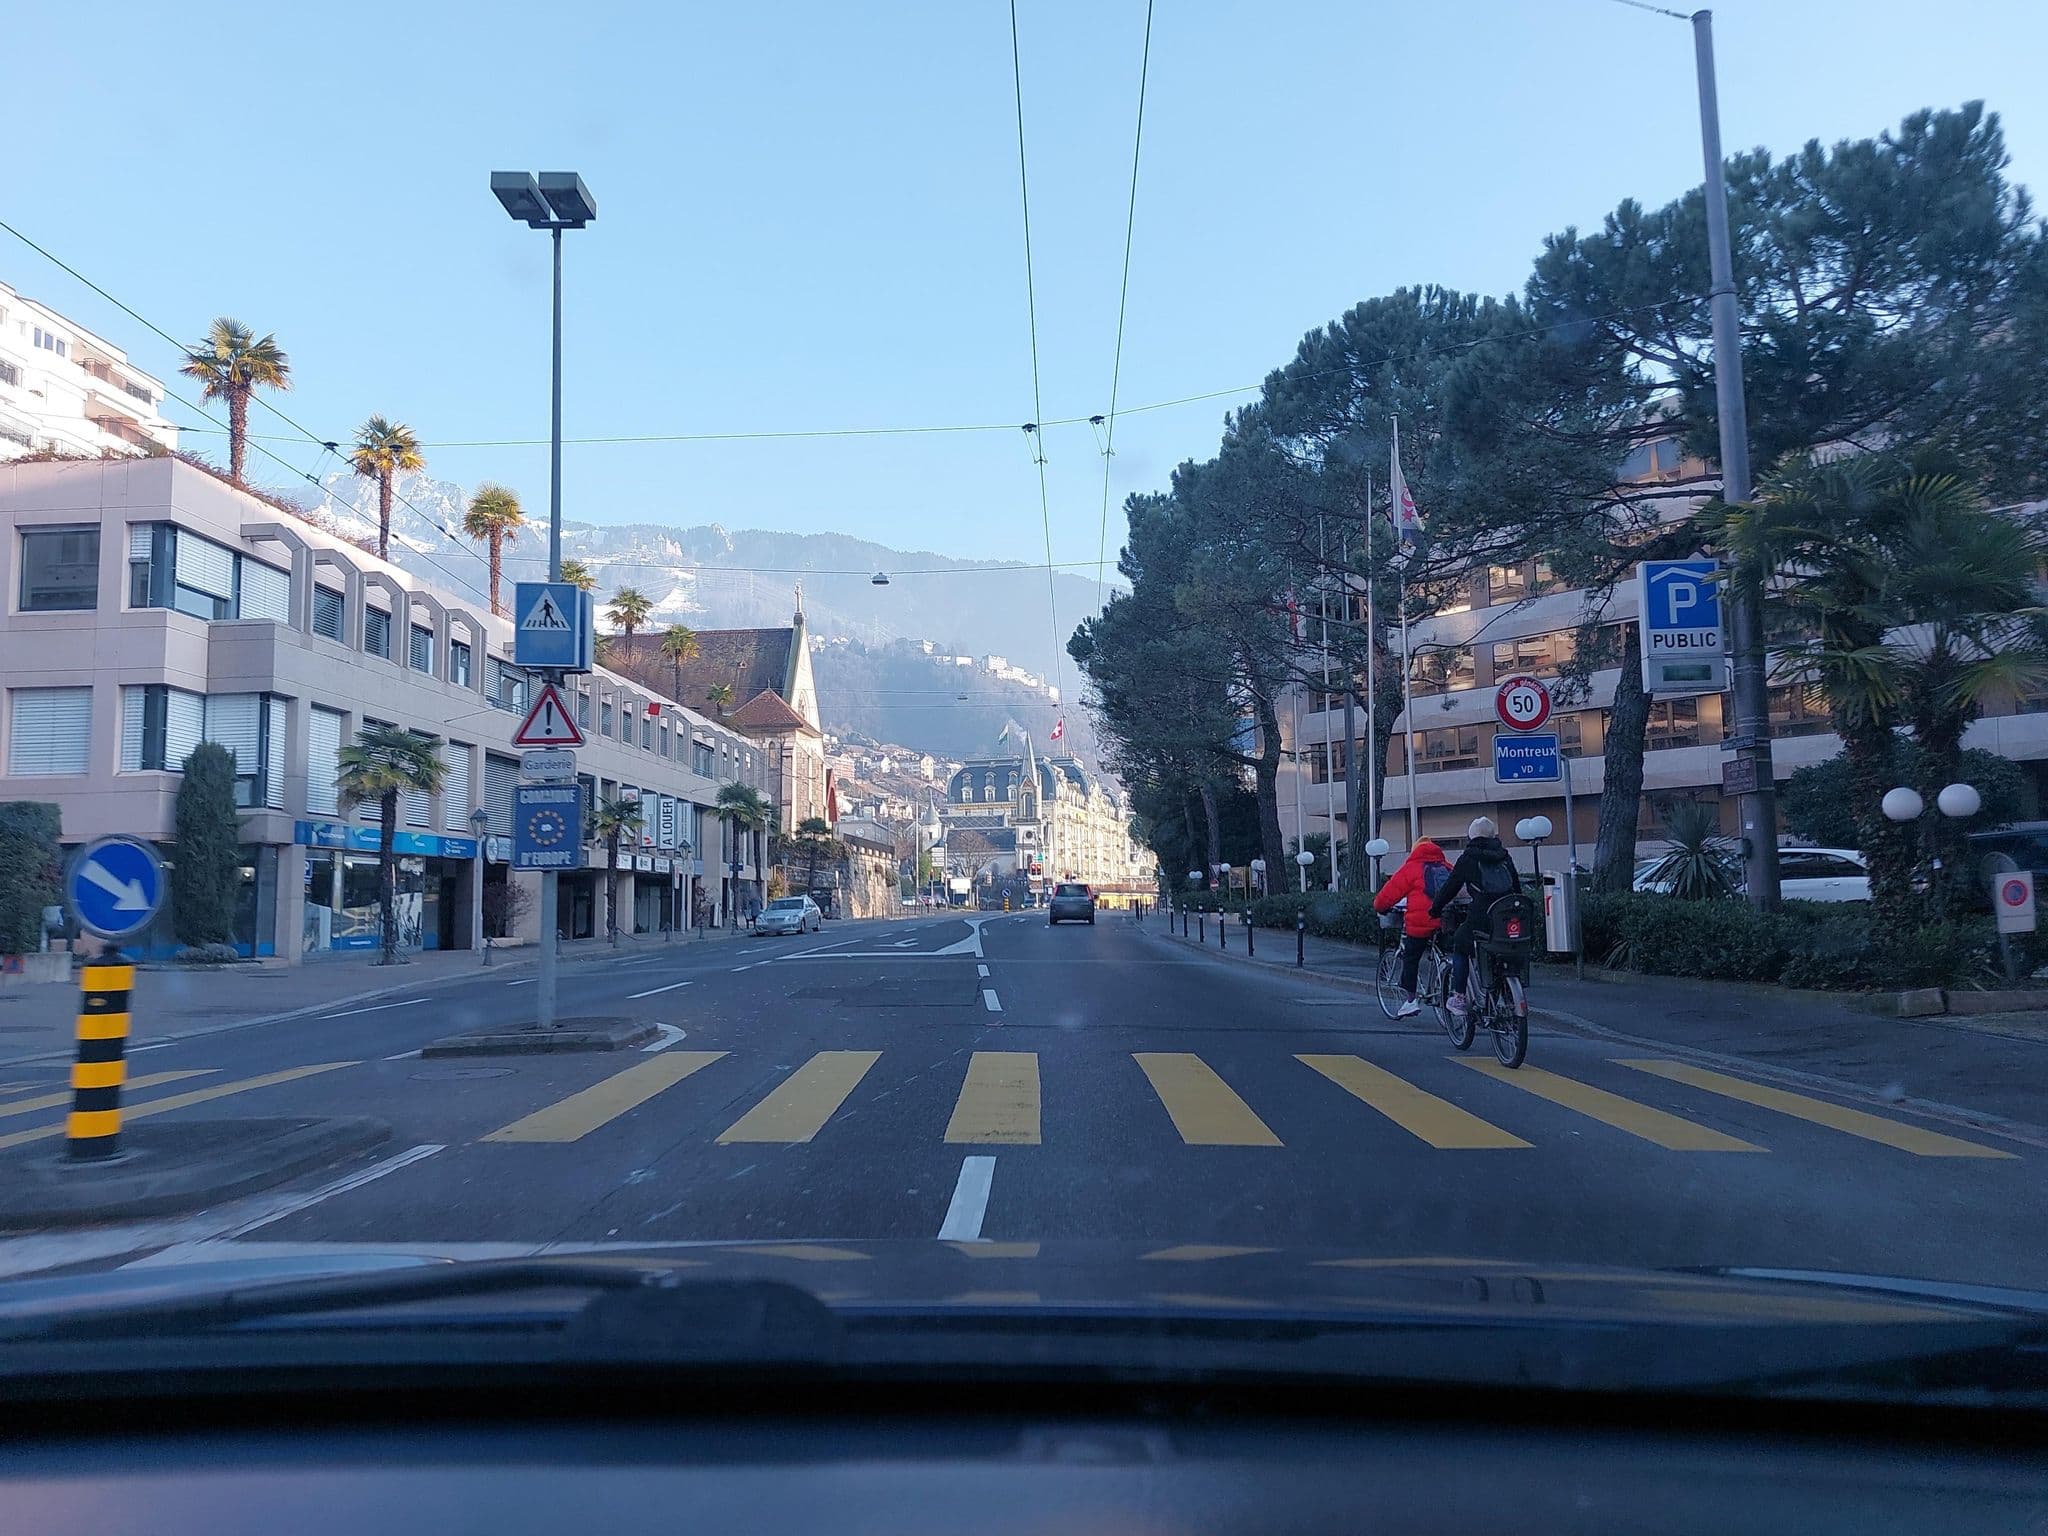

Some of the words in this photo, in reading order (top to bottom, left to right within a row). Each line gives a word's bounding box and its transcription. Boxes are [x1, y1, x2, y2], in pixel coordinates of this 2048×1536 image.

[1668, 582, 1697, 624] P
[1653, 632, 1717, 648] PUBLIC
[1513, 695, 1533, 713] 50
[1498, 746, 1556, 758] Montreux
[524, 759, 572, 770] Garderie
[1521, 765, 1534, 774] VD
[662, 801, 673, 835] LOUER
[662, 838, 673, 846] A
